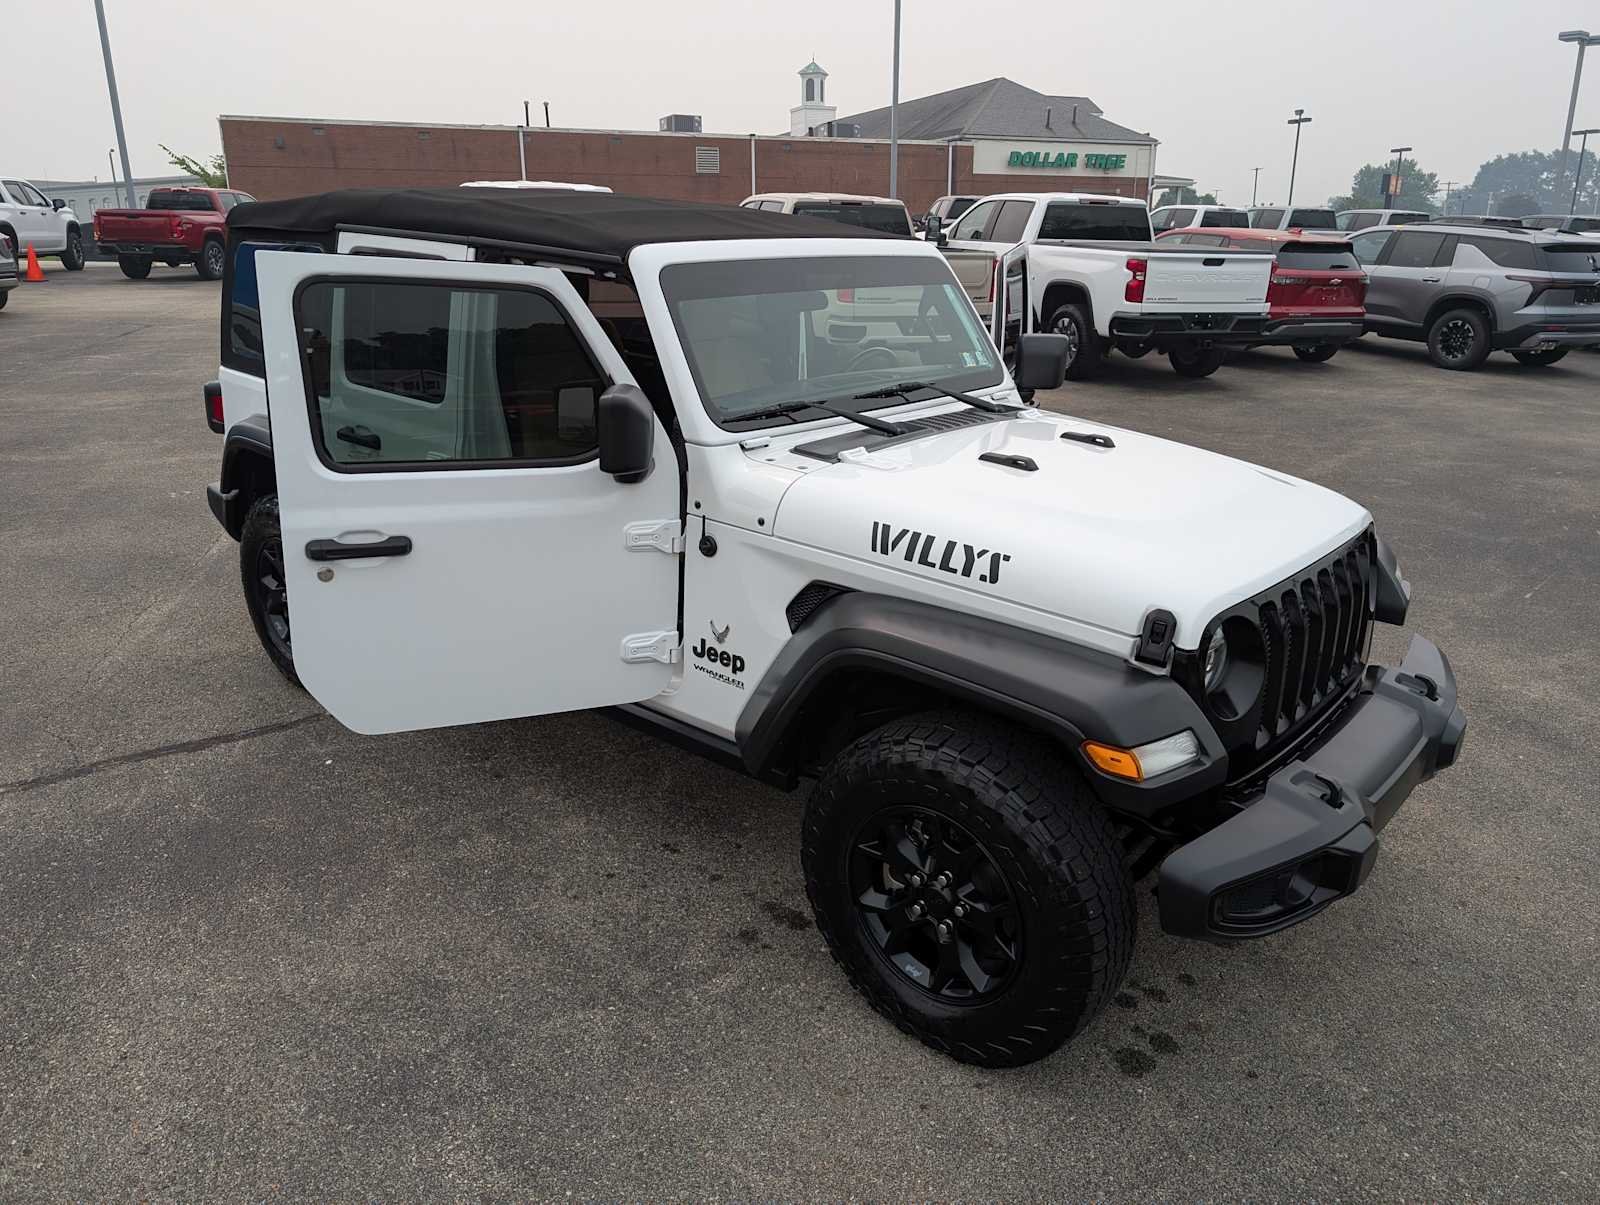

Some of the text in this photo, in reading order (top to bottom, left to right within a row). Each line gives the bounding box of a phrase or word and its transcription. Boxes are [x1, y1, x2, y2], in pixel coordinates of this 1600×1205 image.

[1008, 151, 1127, 169] DOLLAR TREE
[871, 520, 1012, 585] WILLYS
[692, 637, 746, 675] Jeep
[693, 662, 745, 688] WRANGLER
